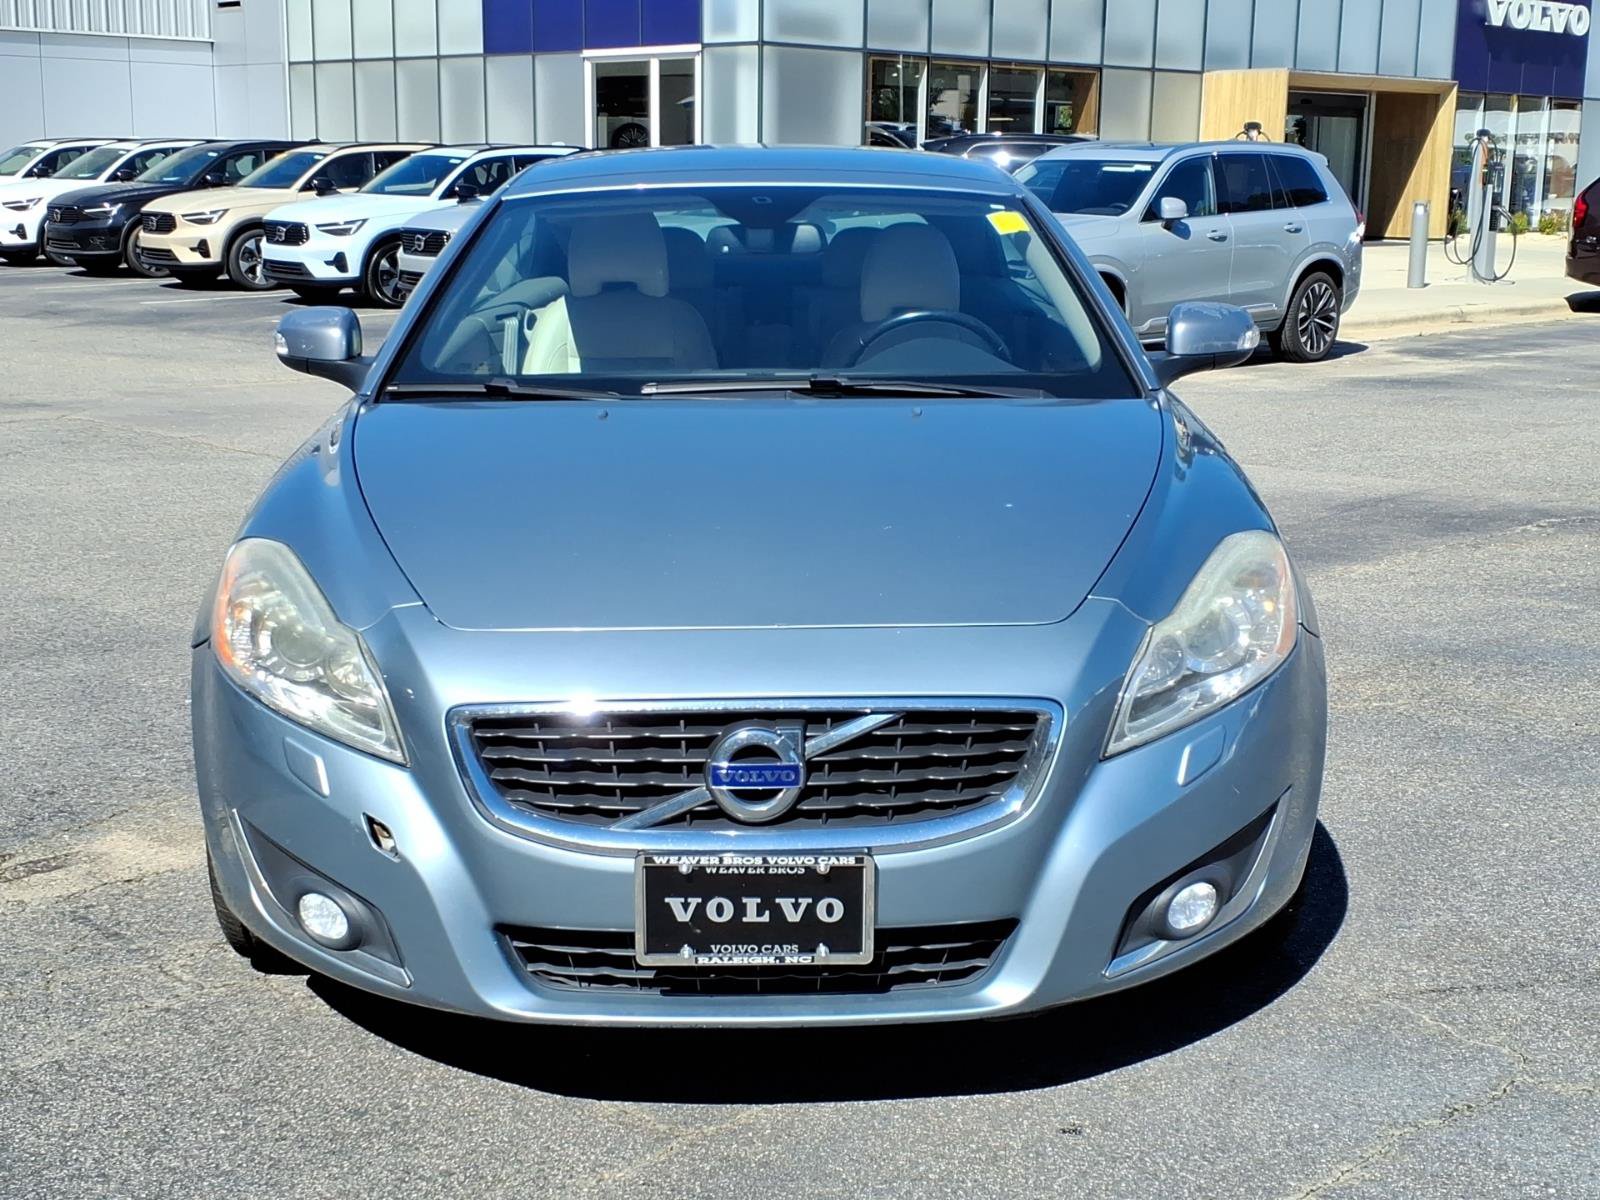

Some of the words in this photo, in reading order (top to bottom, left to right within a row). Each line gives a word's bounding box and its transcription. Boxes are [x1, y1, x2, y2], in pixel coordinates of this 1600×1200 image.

[1485, 0, 1590, 36] VOLVO
[716, 770, 796, 783] VOLVO
[652, 856, 720, 866] WEAVER
[723, 856, 763, 866] BROS
[767, 856, 815, 866] VOLVO
[817, 856, 856, 866] CARS
[664, 897, 845, 923] VOLVO
[710, 944, 758, 954] VOLVO
[761, 944, 799, 954] CARS
[784, 956, 812, 964] NC
